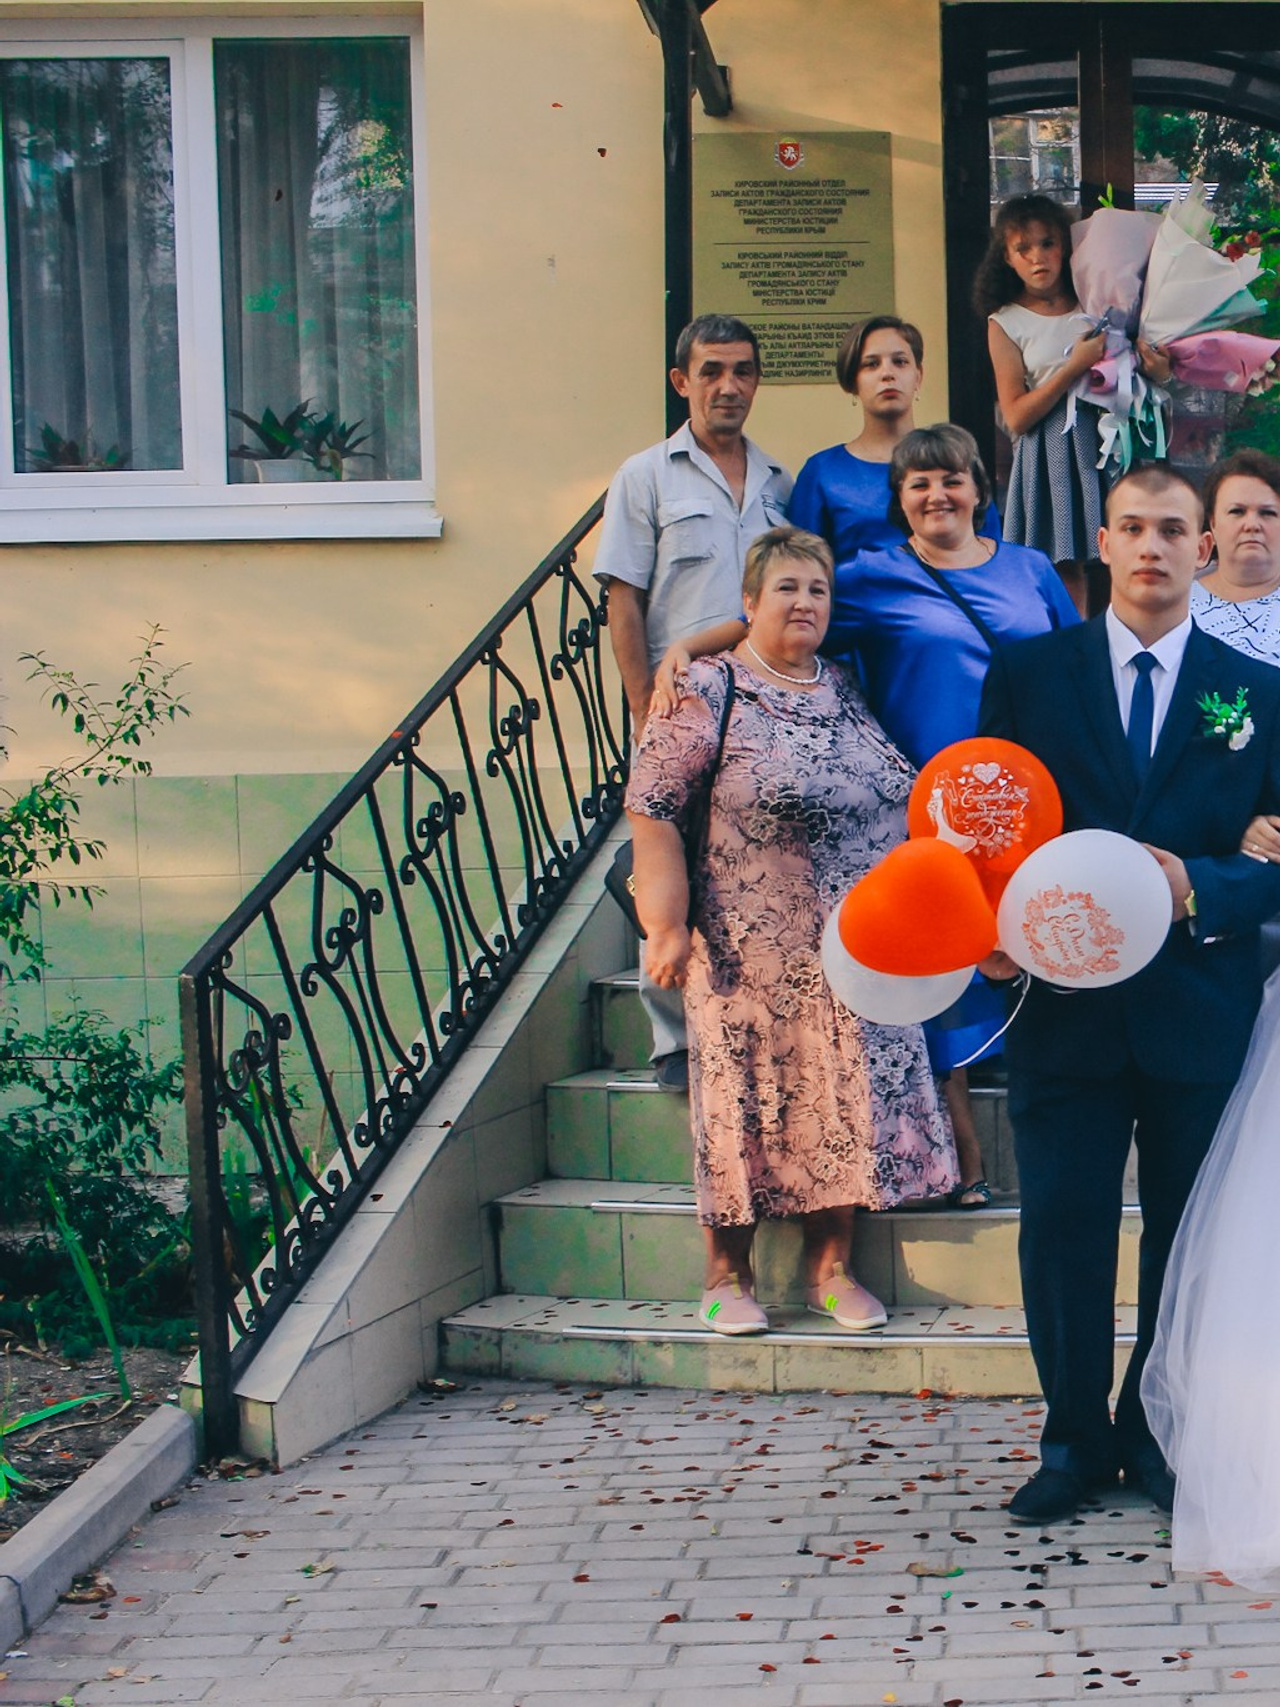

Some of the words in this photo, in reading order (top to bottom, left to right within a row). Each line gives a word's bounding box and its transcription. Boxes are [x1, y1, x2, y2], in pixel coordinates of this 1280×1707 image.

[734, 179, 777, 188] КИРОВСКИЙ
[779, 179, 820, 187] РАЙОННЫЙ
[821, 179, 846, 187] ОТДЕЛ
[710, 190, 740, 198] ЗАПИСИ
[741, 190, 765, 198] АКТОВ
[766, 189, 825, 198] ГРАЖДАНСКОГО
[826, 189, 870, 197] СОСТОЯНИЯ
[733, 199, 791, 208] ДЕПАРТАМЕНТА
[792, 198, 822, 206] ЗАПИСИ
[822, 198, 847, 206] АКТОВ
[738, 208, 797, 217] ГРАЖДАНСКОГО
[797, 207, 843, 215] СОСТОЯНИЯ
[743, 217, 801, 225] МИНИСТЕРСТВА
[802, 217, 839, 225] ЮСТИЦИИ
[756, 226, 803, 235] РЕСПУБЛИКИ
[804, 226, 826, 234] КРЫМ
[737, 251, 783, 260] КІРОВСЬКИЙ
[783, 251, 823, 259] РАЙОННИЙ
[720, 261, 749, 270] ЗАПИСУ
[750, 261, 771, 269] АКТІВ
[772, 260, 841, 269] ГРОМАДЯНСЬКОГО
[841, 260, 865, 268] СТАНУ
[738, 270, 796, 279] ДЕПАРТАМЕНТА
[797, 270, 826, 278] ЗАПИСУ
[827, 270, 848, 278] АКТІВ
[747, 279, 815, 288] ГРОМАДЯНСЬКОГО
[816, 279, 840, 288] СТАНУ
[752, 289, 804, 297] МІНІСТЕРСТВА
[806, 298, 827, 306] КРИМ
[769, 322, 800, 331] РАЙОНЫ
